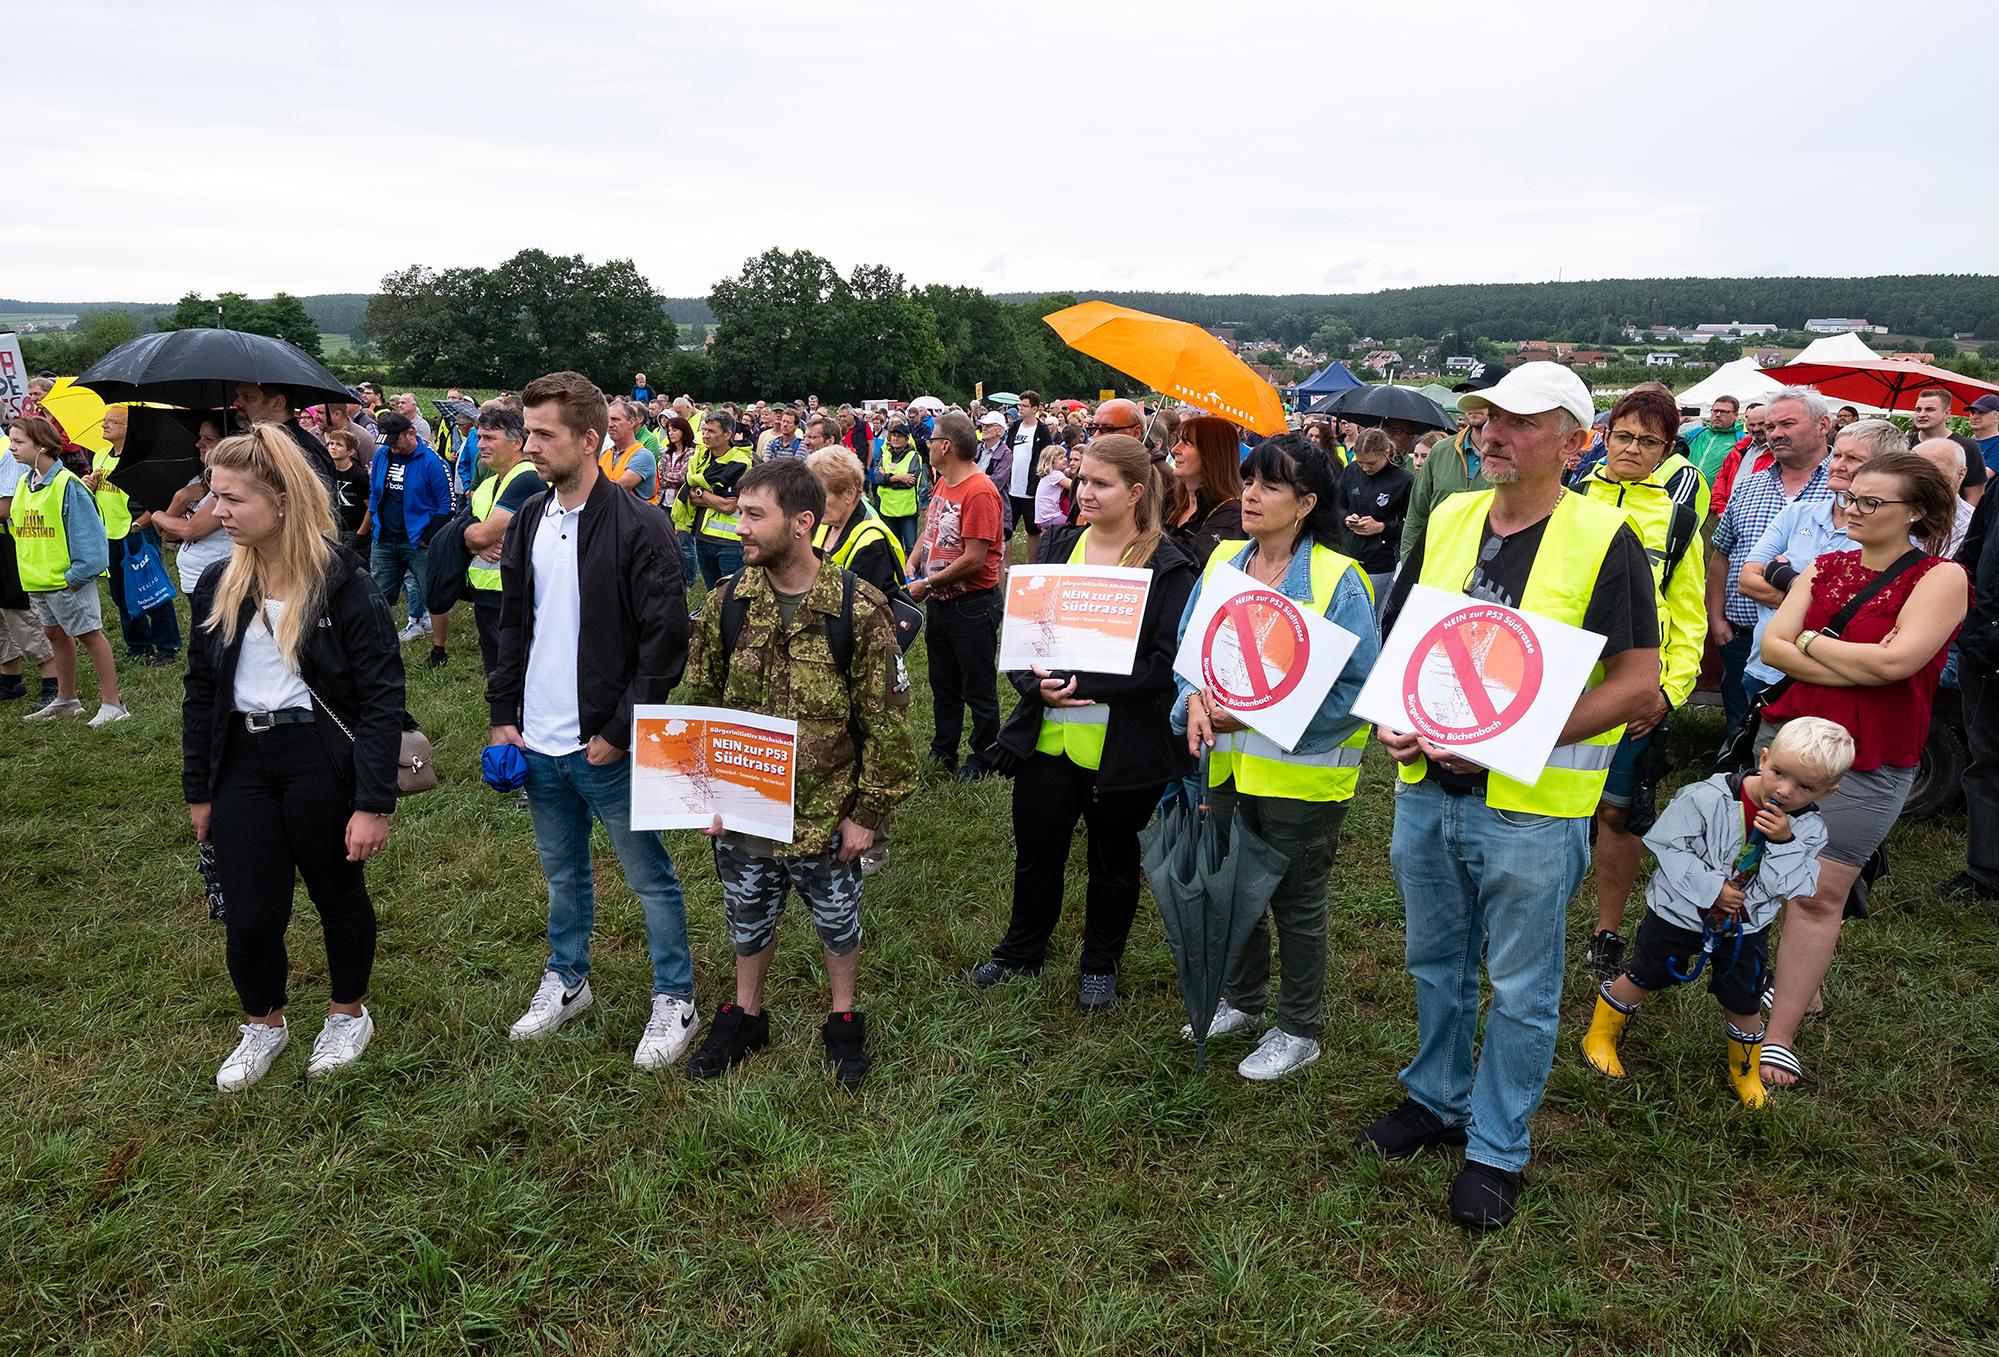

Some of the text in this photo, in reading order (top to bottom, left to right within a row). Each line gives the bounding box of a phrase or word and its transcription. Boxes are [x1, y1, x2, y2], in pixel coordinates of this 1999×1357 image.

[1175, 384, 1208, 403] space
[1061, 600, 1134, 616] Südtrasse
[1062, 590, 1138, 604] NEIN zur P53
[1235, 594, 1255, 606] NEIN
[1269, 597, 1284, 609] P53
[1283, 603, 1305, 643] Südtrasse
[1443, 610, 1535, 654] NEIN zur P53 Südtrasse
[1203, 657, 1273, 707] Bürgerinitiative Büchenbach
[1407, 693, 1501, 741] Bürgerinitiative Büchenbach
[709, 726, 794, 747] Bürgerinitiative Büchenbach
[712, 738, 789, 762] NEIN zur P53
[714, 751, 786, 776] Südtrasse
